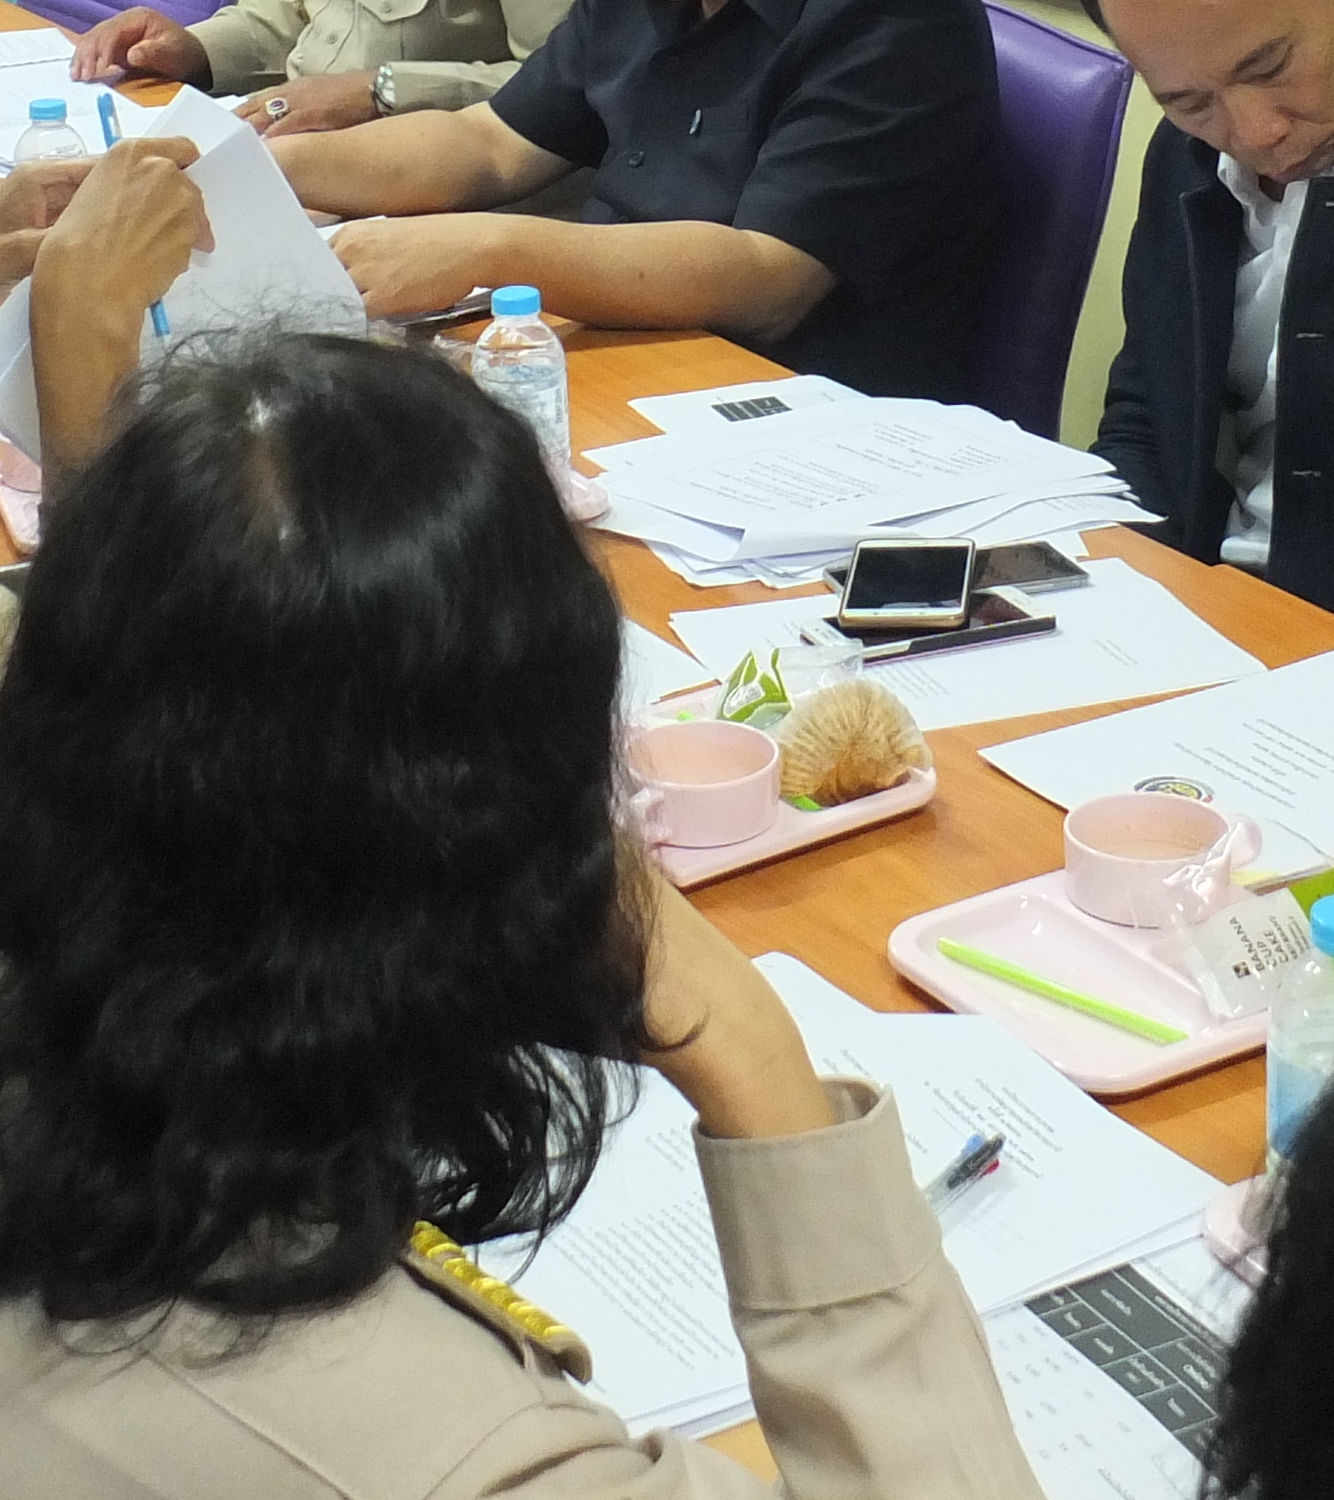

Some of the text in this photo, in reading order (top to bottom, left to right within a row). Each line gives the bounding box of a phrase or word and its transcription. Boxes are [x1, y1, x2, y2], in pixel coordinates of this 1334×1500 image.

[1230, 916, 1265, 971] BANANA
[1257, 941, 1277, 967] CUP
[1263, 931, 1289, 963] CAKE
